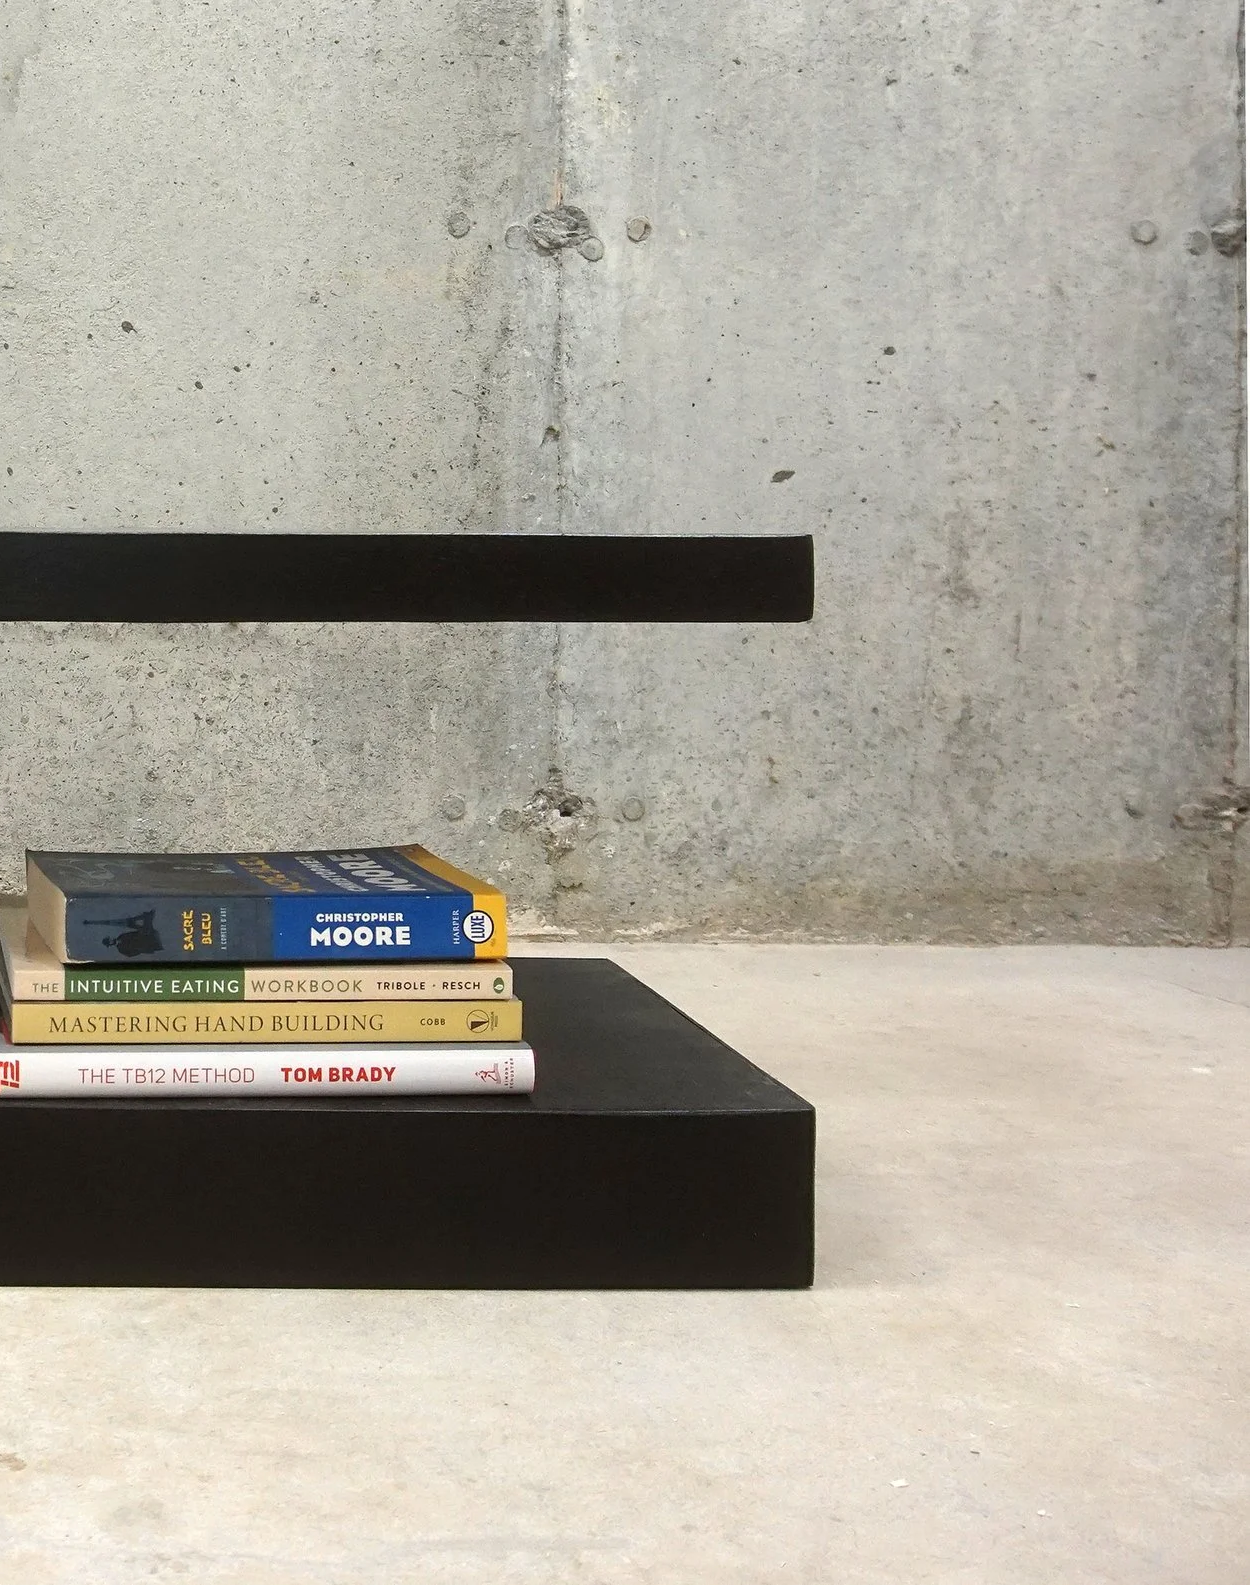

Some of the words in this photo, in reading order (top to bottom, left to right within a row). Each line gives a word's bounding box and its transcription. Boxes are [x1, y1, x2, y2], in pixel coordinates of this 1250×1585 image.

[326, 853, 427, 892] MOORE
[315, 912, 404, 923] CHRISTOPHER
[452, 909, 460, 945] HARPER
[470, 915, 485, 939] LUXE
[182, 909, 194, 951] SACRÉ
[201, 912, 213, 945] BLEU
[310, 926, 411, 947] MOORE
[32, 982, 59, 993] THE
[70, 980, 163, 994] INTUITIVE
[171, 979, 240, 994] EATING
[250, 979, 363, 994] WORKBOOK
[376, 981, 426, 991] TRIBOLE
[442, 981, 481, 991] RESCH
[49, 1016, 187, 1033] MASTERING
[194, 1015, 264, 1032] HAND
[271, 1014, 385, 1032] BUILDING
[419, 1017, 446, 1026] COBB
[78, 1068, 116, 1084] THE
[122, 1068, 166, 1084] TB12
[172, 1067, 255, 1084] METHOD
[281, 1067, 323, 1083] TOM
[328, 1066, 397, 1083] BRADY
